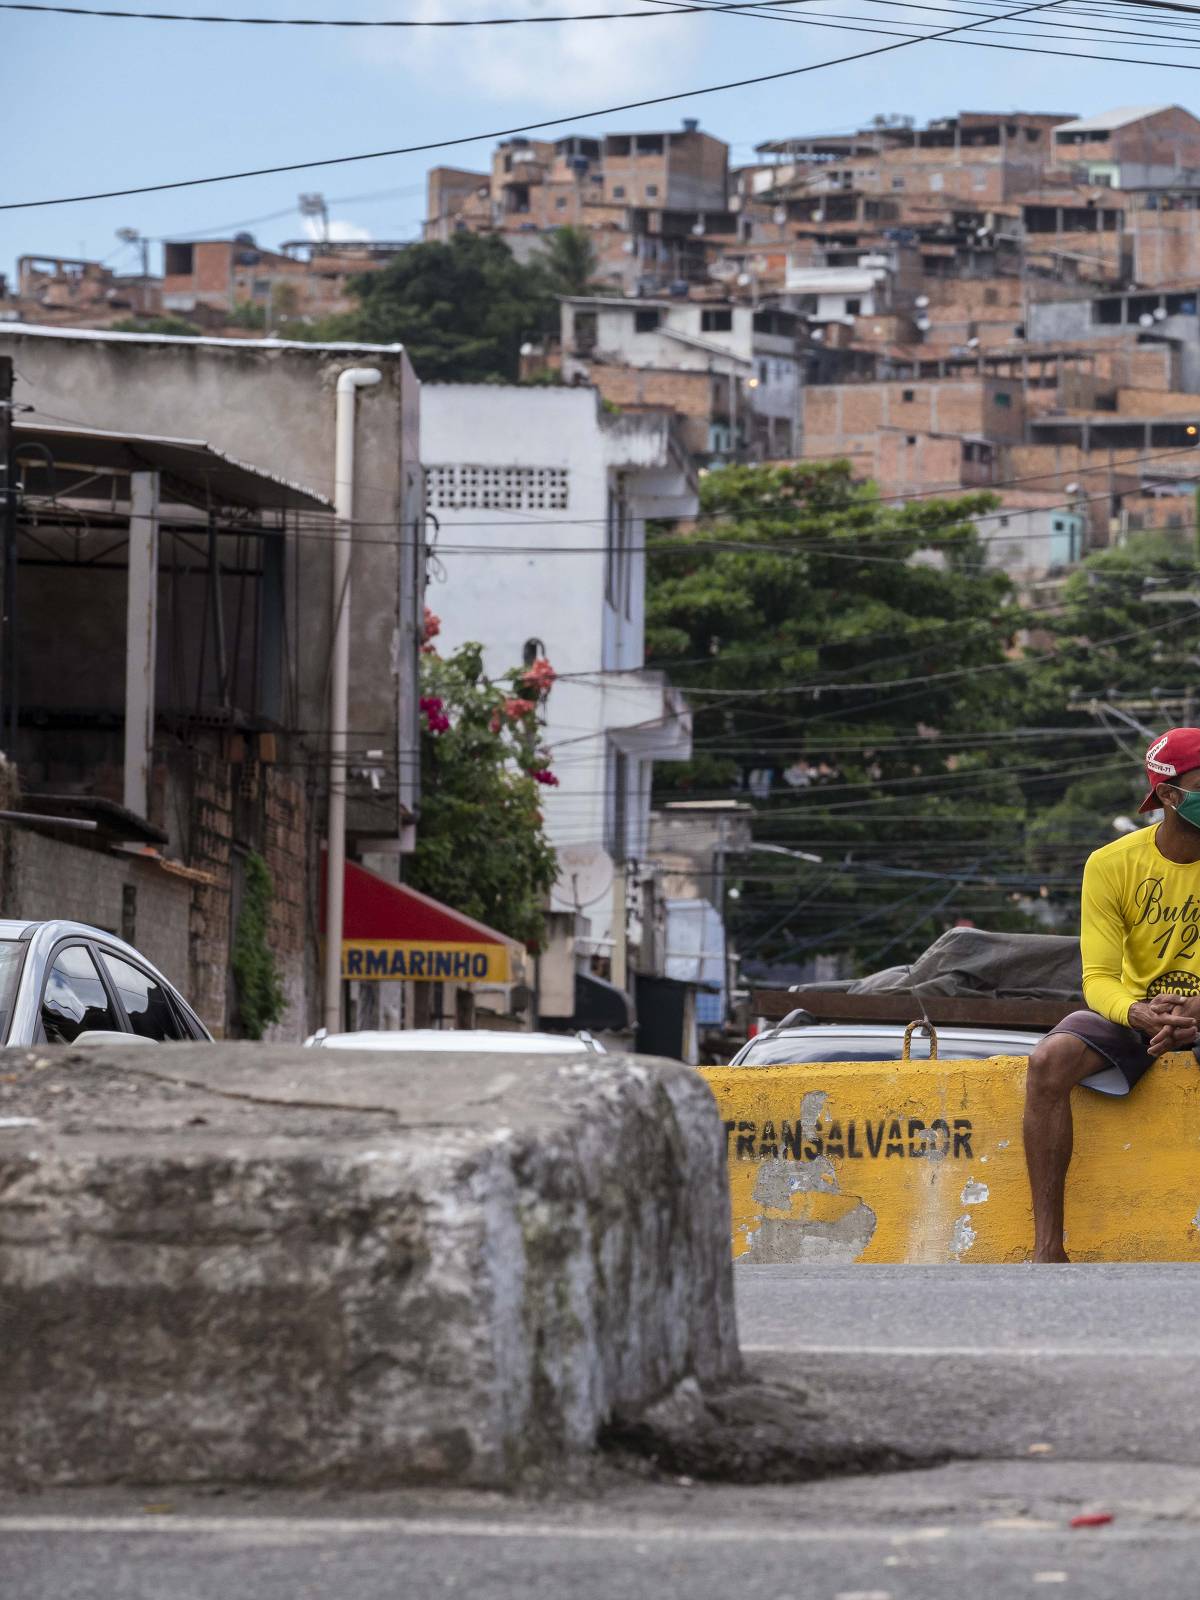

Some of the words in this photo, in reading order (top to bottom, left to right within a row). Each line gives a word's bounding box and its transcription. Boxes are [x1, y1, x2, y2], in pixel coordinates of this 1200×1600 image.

[1153, 923, 1200, 960] 12
[341, 947, 489, 978] RMARINHO
[724, 1119, 975, 1161] TRANSALVADOR
